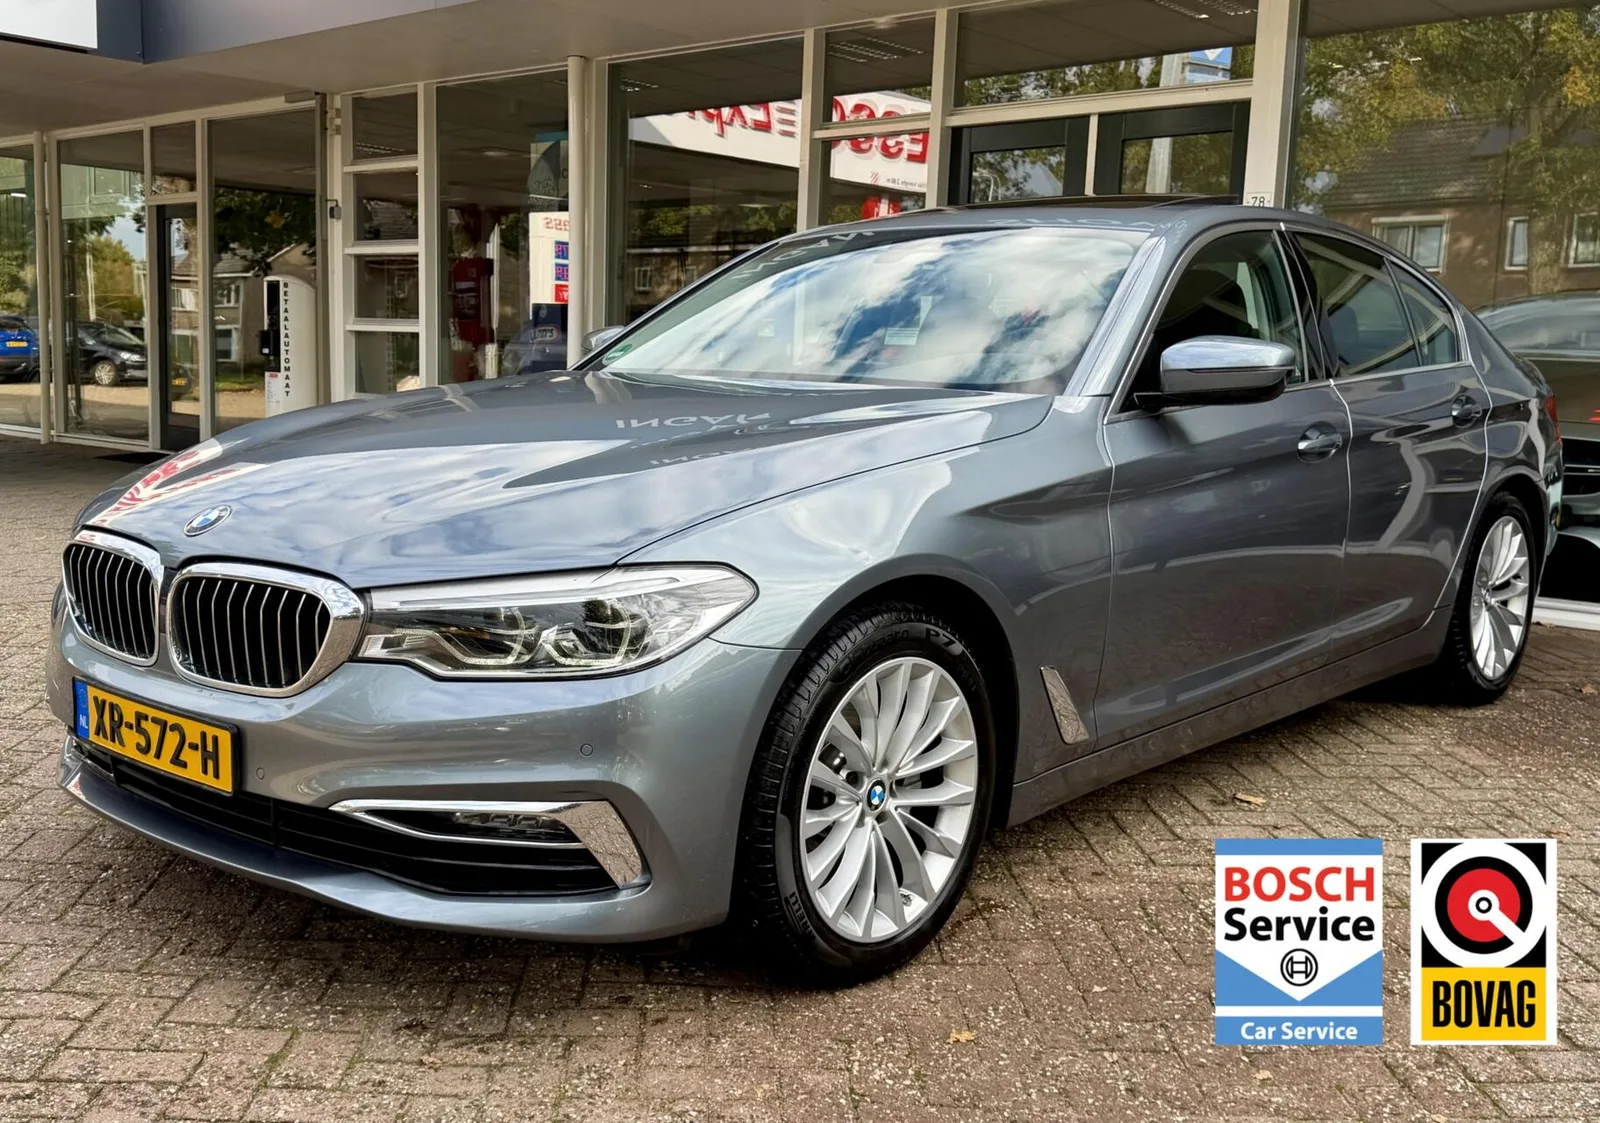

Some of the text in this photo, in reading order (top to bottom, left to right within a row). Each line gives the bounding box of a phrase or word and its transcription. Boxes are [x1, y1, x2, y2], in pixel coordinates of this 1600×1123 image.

[1251, 196, 1266, 207] 78
[283, 282, 291, 397] BETAALAUTOMAAT
[925, 627, 957, 648] P7
[79, 713, 89, 730] NL
[93, 695, 220, 780] XR-572-H
